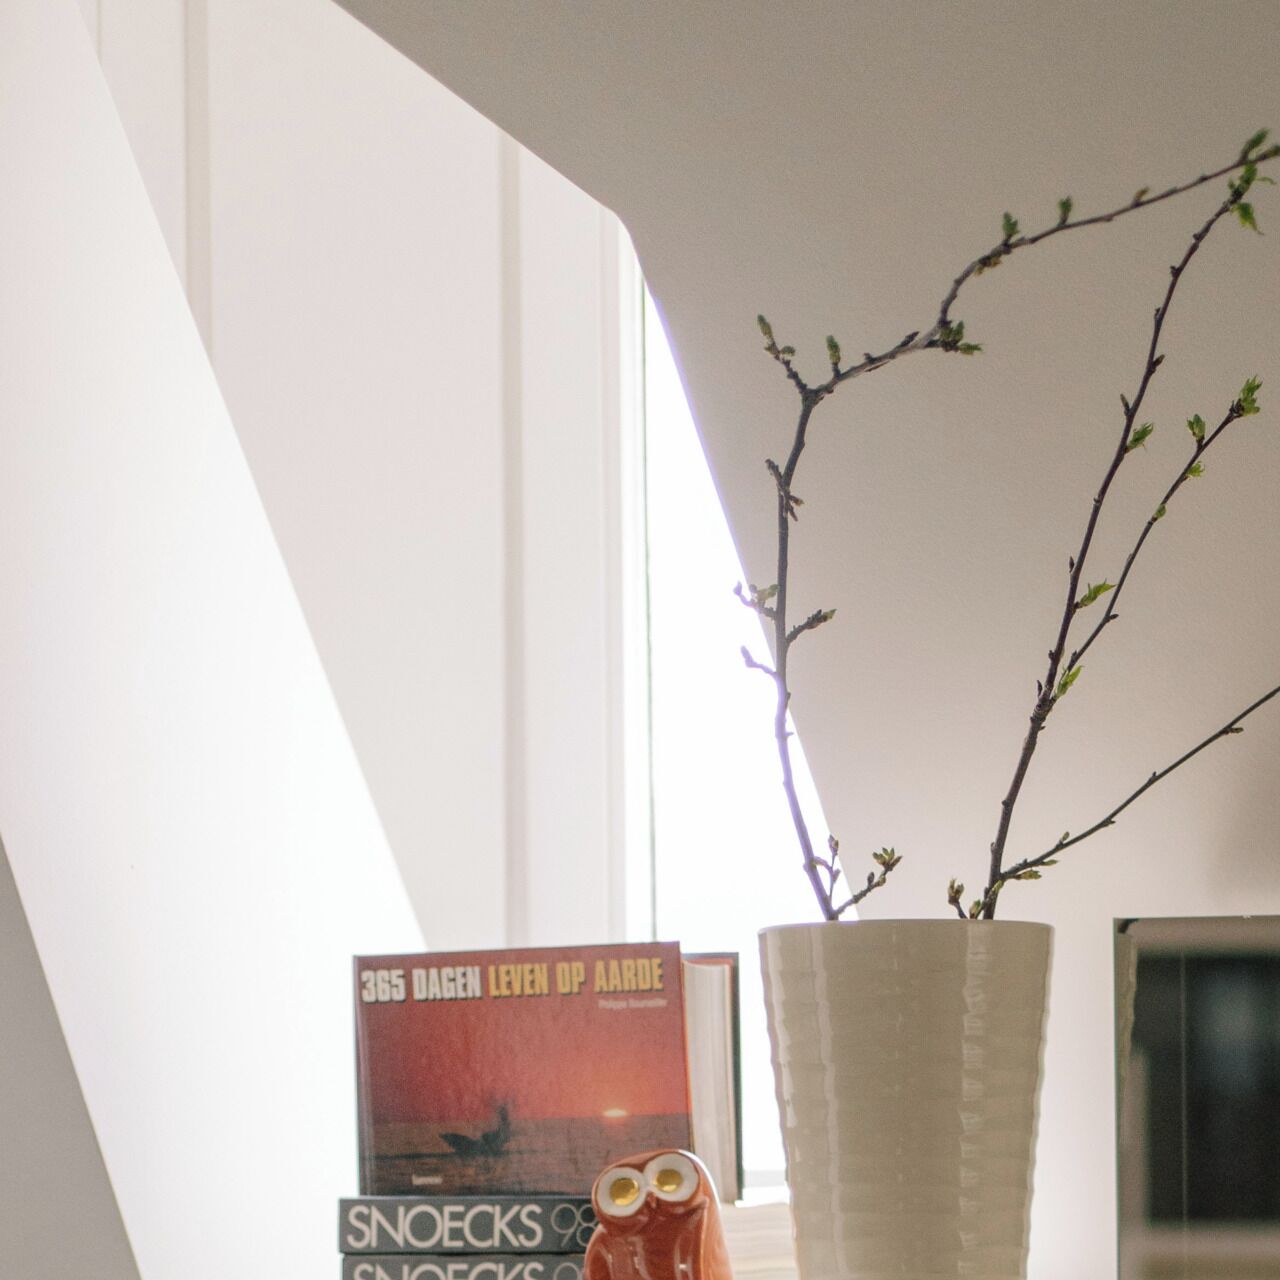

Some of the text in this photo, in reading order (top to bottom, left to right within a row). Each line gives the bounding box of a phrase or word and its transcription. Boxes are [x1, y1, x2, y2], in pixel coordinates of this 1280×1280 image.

[361, 958, 664, 1003] 365 DAGEN LEVEN OP AARDE
[347, 1203, 543, 1249] SNOECKS
